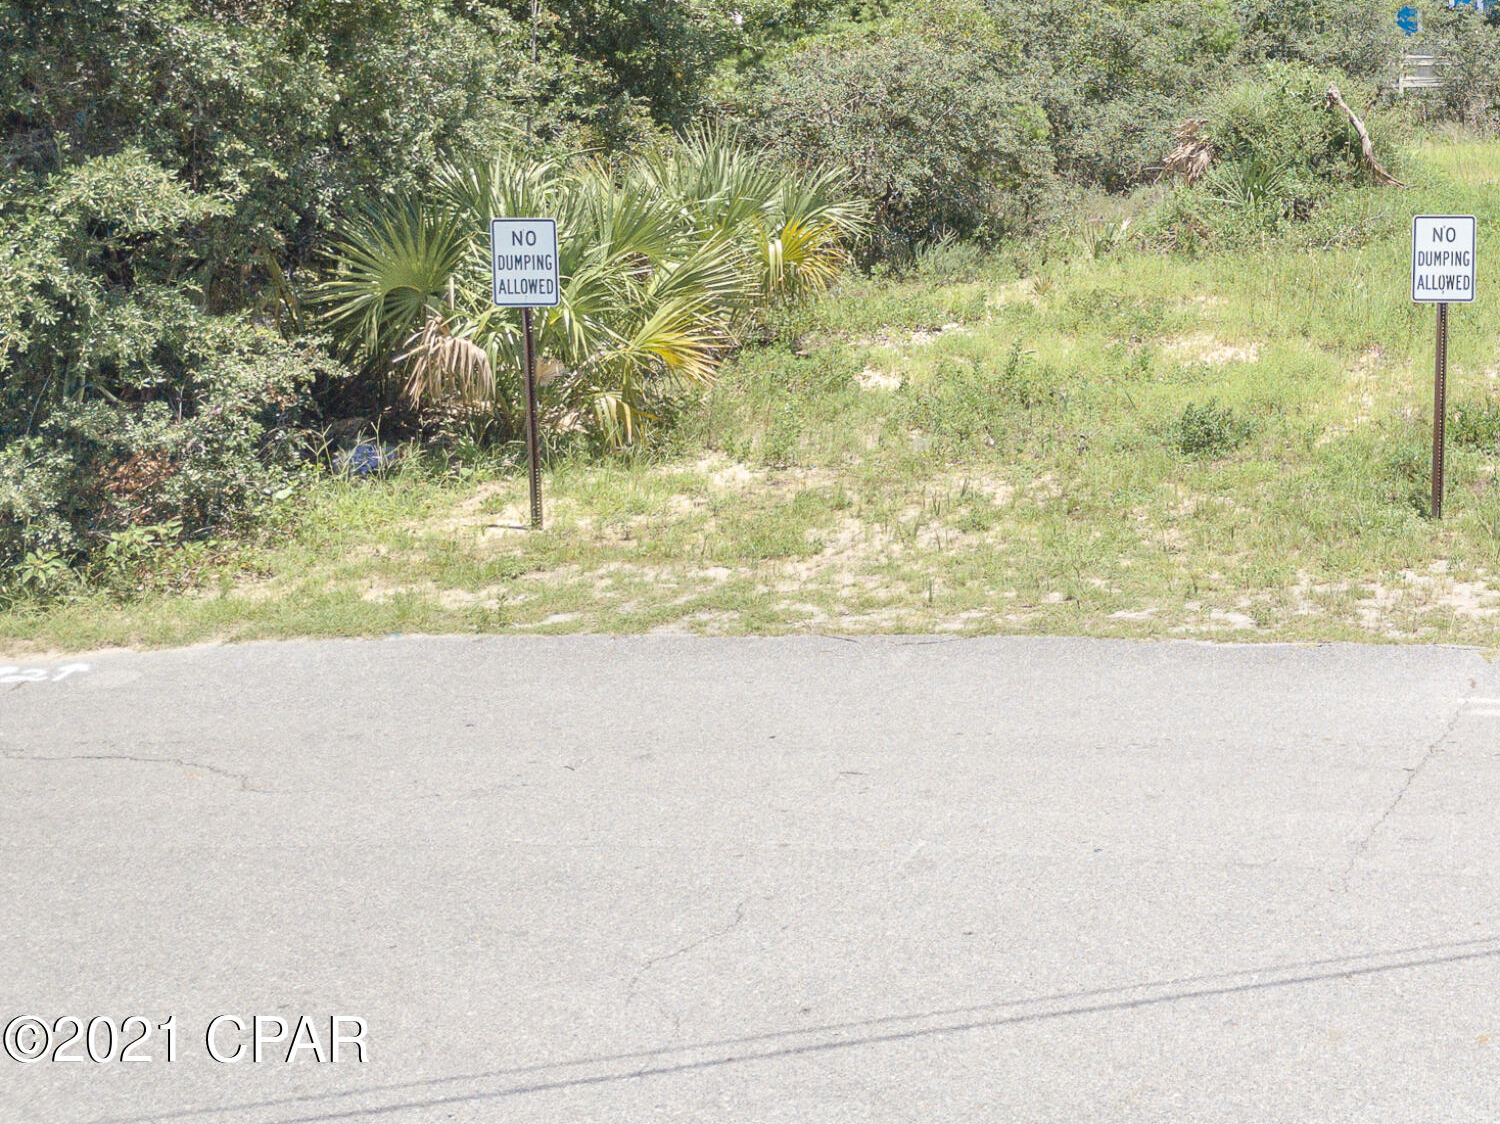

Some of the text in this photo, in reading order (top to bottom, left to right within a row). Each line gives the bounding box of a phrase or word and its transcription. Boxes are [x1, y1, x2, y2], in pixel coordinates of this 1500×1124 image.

[511, 230, 537, 247] NO
[1432, 227, 1456, 243] NO
[497, 254, 553, 271] DUMPING
[1417, 250, 1470, 267] DUMPING
[498, 278, 554, 295] ALLOWED
[1416, 274, 1471, 291] ALLOWED
